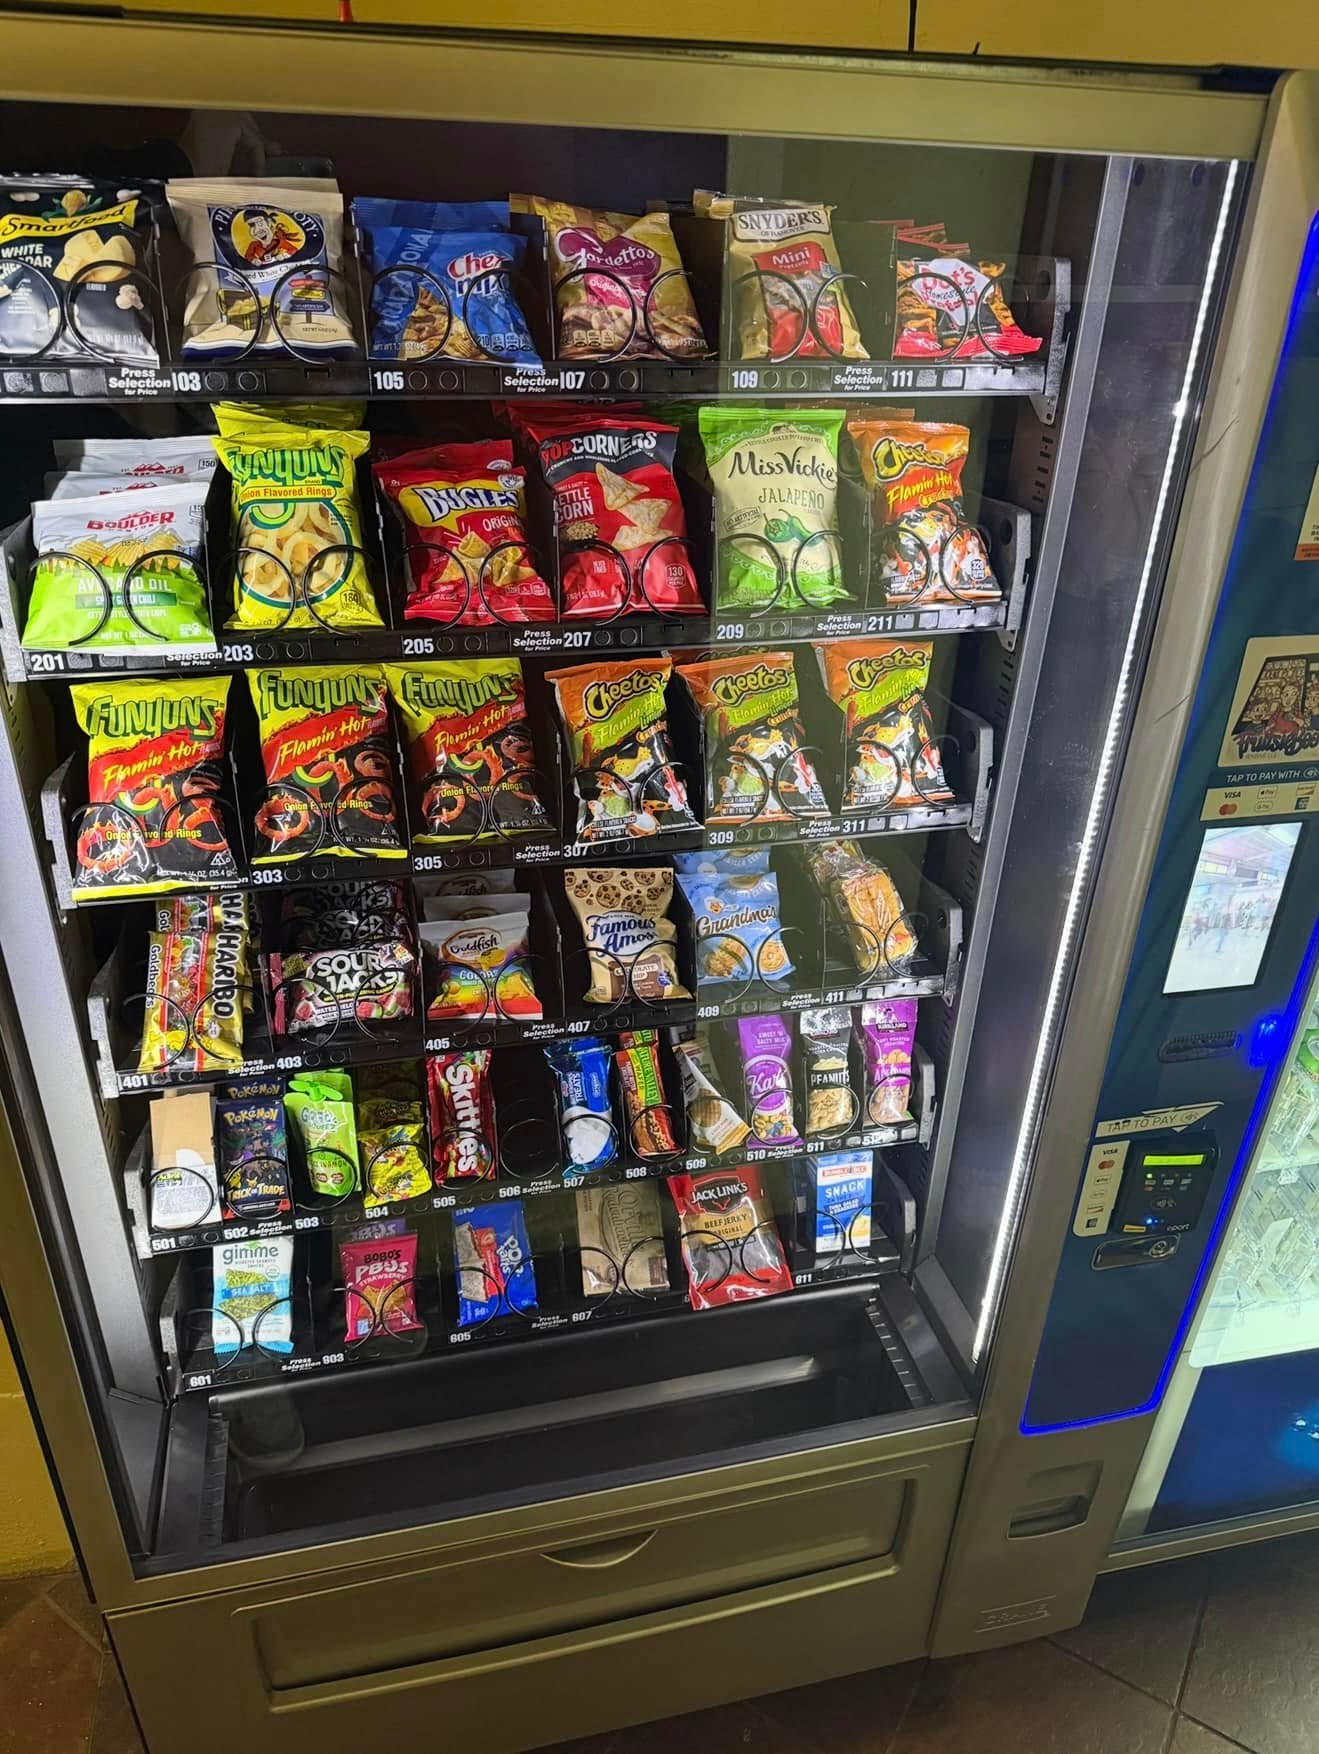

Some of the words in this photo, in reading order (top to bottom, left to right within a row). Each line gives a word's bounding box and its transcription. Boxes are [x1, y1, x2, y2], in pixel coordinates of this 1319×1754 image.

[2, 205, 129, 236] Smartfood
[737, 210, 824, 231] SNYDER'S
[1, 243, 44, 259] WHITE
[773, 246, 812, 266] Mini
[447, 250, 514, 279] Chex
[121, 367, 155, 379] Press
[515, 367, 546, 377] Press
[845, 366, 873, 376] Press
[108, 377, 171, 390] Selection
[172, 371, 202, 392] 103
[373, 371, 405, 391] 105
[504, 375, 559, 387] Selection
[560, 371, 586, 391] 107
[731, 371, 758, 389] 109
[834, 374, 883, 386] Selection
[891, 371, 914, 388] 111
[728, 451, 782, 481] Miss
[263, 487, 304, 498] Flavored
[306, 486, 333, 498] Rings
[758, 487, 825, 510] JALAPEÑO
[413, 486, 520, 523] BUGLES
[555, 502, 594, 521] CORN
[86, 511, 176, 531] BOULDER
[669, 566, 684, 577] 130
[150, 578, 172, 592] OIL
[827, 615, 852, 624] Press
[867, 615, 892, 631] 211
[717, 624, 744, 640] 209
[817, 621, 861, 632] Selection
[524, 629, 551, 640] Press
[564, 631, 592, 648] 207
[404, 638, 434, 655] 205
[513, 636, 562, 648] Selection
[167, 649, 223, 662] Selection
[223, 645, 254, 662] 203
[31, 652, 65, 673] 201
[848, 647, 926, 690] Cheetos
[713, 663, 790, 706] Cheetos
[585, 670, 664, 720] Cheetos
[483, 707, 509, 726] Hot
[279, 725, 336, 766] Flamin'
[340, 716, 371, 738] Hot
[168, 740, 202, 761] Hot
[1226, 774, 1244, 784] TAP
[1245, 773, 1258, 782] TO
[1258, 771, 1277, 782] PAY
[1277, 769, 1301, 780] WITH
[440, 787, 464, 799] Onion
[502, 781, 523, 793] Rings
[1224, 791, 1242, 800] VISA
[283, 800, 308, 811] Onion
[349, 799, 373, 810] Rings
[800, 825, 841, 836] Selection
[808, 820, 832, 829] Press
[842, 820, 865, 833] 311
[175, 828, 202, 840] Rings
[709, 831, 734, 845] 309
[515, 849, 560, 860] Selection
[524, 844, 550, 853] Press
[563, 845, 588, 859] 307
[414, 856, 442, 870] 305
[252, 870, 283, 885] 303
[586, 914, 656, 942] Famous
[696, 904, 778, 940] Grandma's
[449, 934, 499, 956] Goldfish
[603, 932, 654, 953] Amos
[316, 953, 386, 977] SOUR
[211, 933, 242, 1019] HARIBO
[782, 998, 820, 1008] Selection
[825, 992, 844, 1003] 411
[698, 1005, 720, 1018] 409
[523, 1027, 565, 1039] Selection
[532, 1023, 555, 1032] Press
[567, 1021, 591, 1033] 407
[425, 1038, 450, 1051] 405
[229, 1063, 275, 1075] Selection
[276, 1056, 303, 1070] 403
[122, 1074, 148, 1090] 401
[810, 1069, 850, 1087] PEANUTS
[445, 1062, 483, 1173] Skittles
[1106, 1120, 1131, 1133] TAP
[1133, 1118, 1150, 1130] TO
[1152, 1114, 1177, 1127] PAY
[767, 1148, 803, 1158] Selection
[806, 1141, 825, 1153] 511
[746, 1148, 766, 1160] 510
[685, 1159, 707, 1171] 509
[626, 1167, 647, 1180] 508
[530, 1180, 552, 1188] Press
[563, 1176, 584, 1188] 507
[825, 1179, 865, 1198] SNACK
[256, 1182, 286, 1197] TRADE
[499, 1186, 521, 1198] 506
[522, 1183, 561, 1195] Selection
[690, 1186, 717, 1204] JACK
[433, 1197, 456, 1209] 505
[365, 1206, 388, 1219] 504
[258, 1220, 281, 1229] Press
[295, 1217, 319, 1230] 503
[704, 1217, 723, 1229] BEEF
[722, 1212, 748, 1226] JERKY
[223, 1227, 249, 1240] 502
[249, 1224, 293, 1236] Selection
[152, 1238, 176, 1250] 501
[222, 1244, 279, 1265] gimme
[363, 1249, 402, 1264] BOBO'S
[795, 1273, 812, 1285] 611
[531, 1318, 568, 1329] Selection
[572, 1311, 593, 1323] 607
[450, 1332, 471, 1343] 605
[322, 1353, 345, 1366] 603
[281, 1361, 321, 1372] Selection
[189, 1376, 212, 1388] 601
